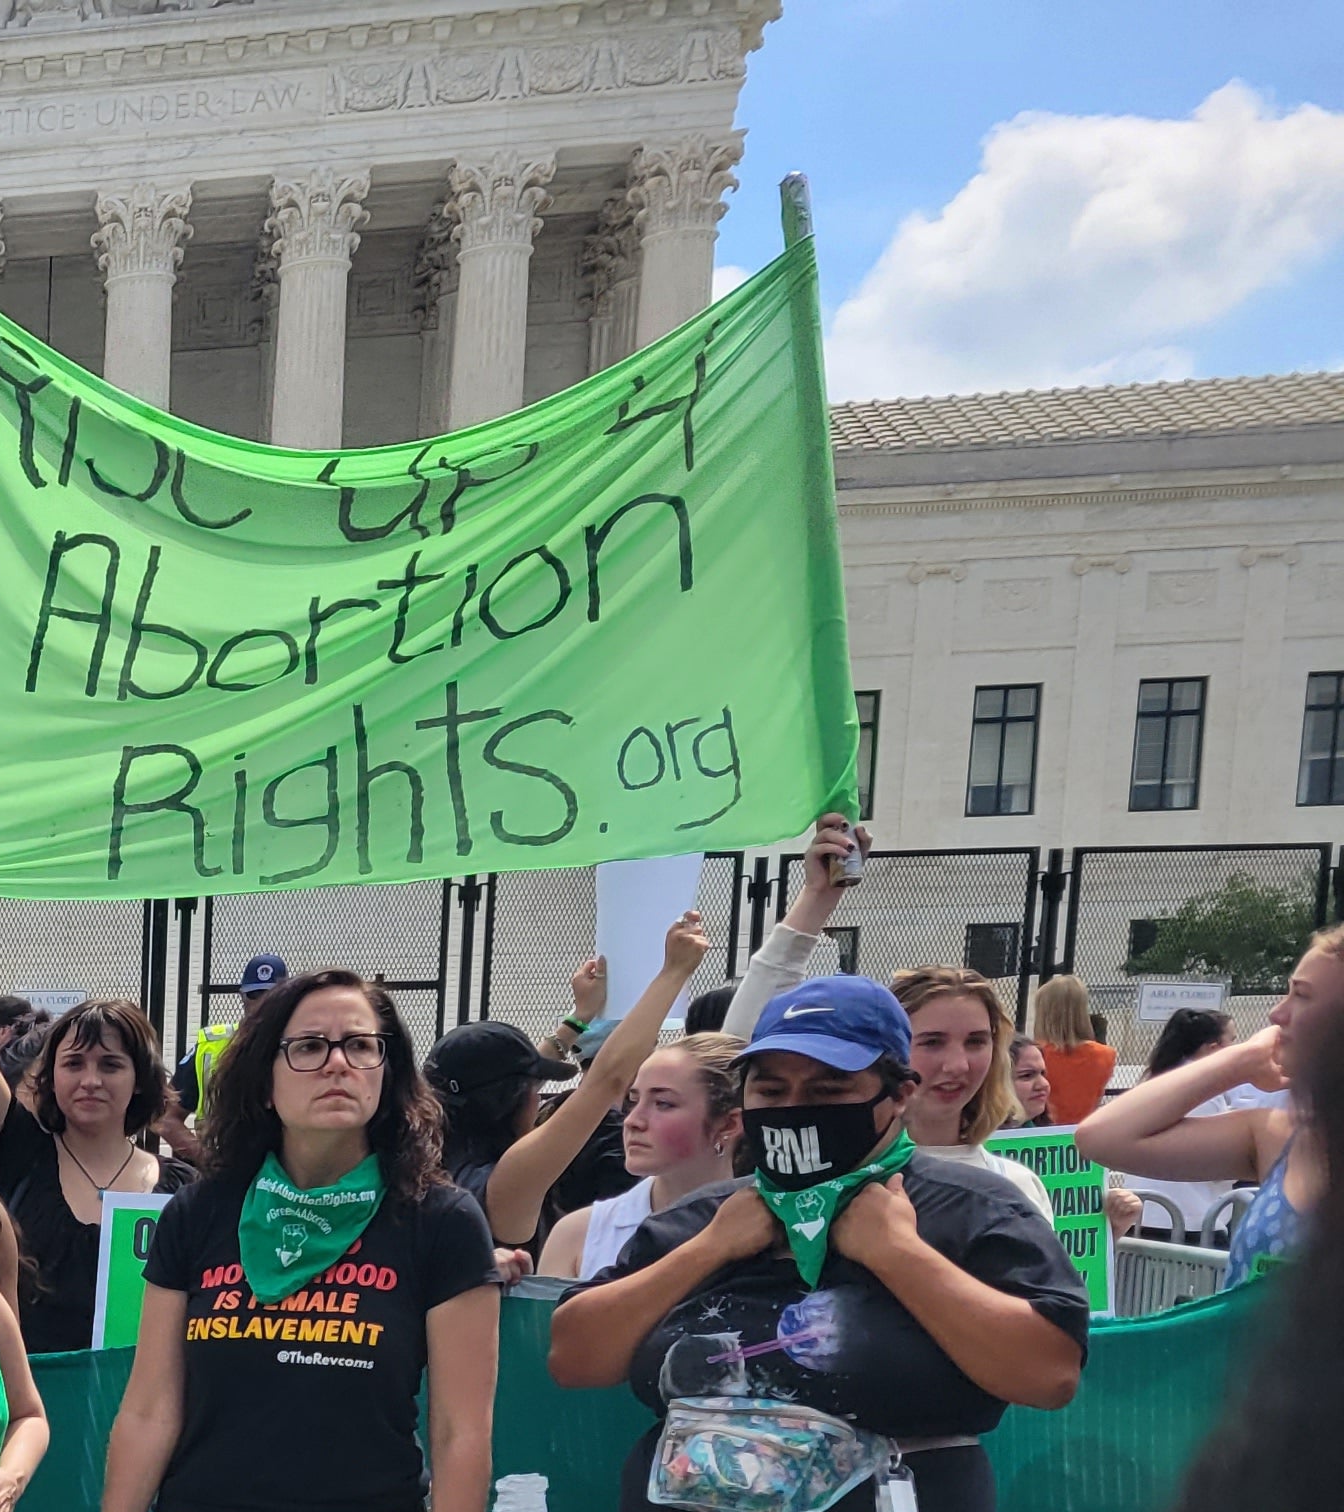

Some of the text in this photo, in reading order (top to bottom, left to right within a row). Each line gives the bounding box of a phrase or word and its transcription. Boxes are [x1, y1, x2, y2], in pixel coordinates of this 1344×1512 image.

[94, 89, 213, 127] UNDER
[230, 84, 302, 114] LAW
[604, 318, 722, 473] 4
[24, 492, 695, 703] Abortion
[106, 682, 742, 887] Rights.org
[46, 996, 79, 1005] CLOSED
[212, 1290, 243, 1311] IS
[186, 1316, 385, 1347] ENSLAVEMENT
[276, 1350, 375, 1370] @TheRevcoms
